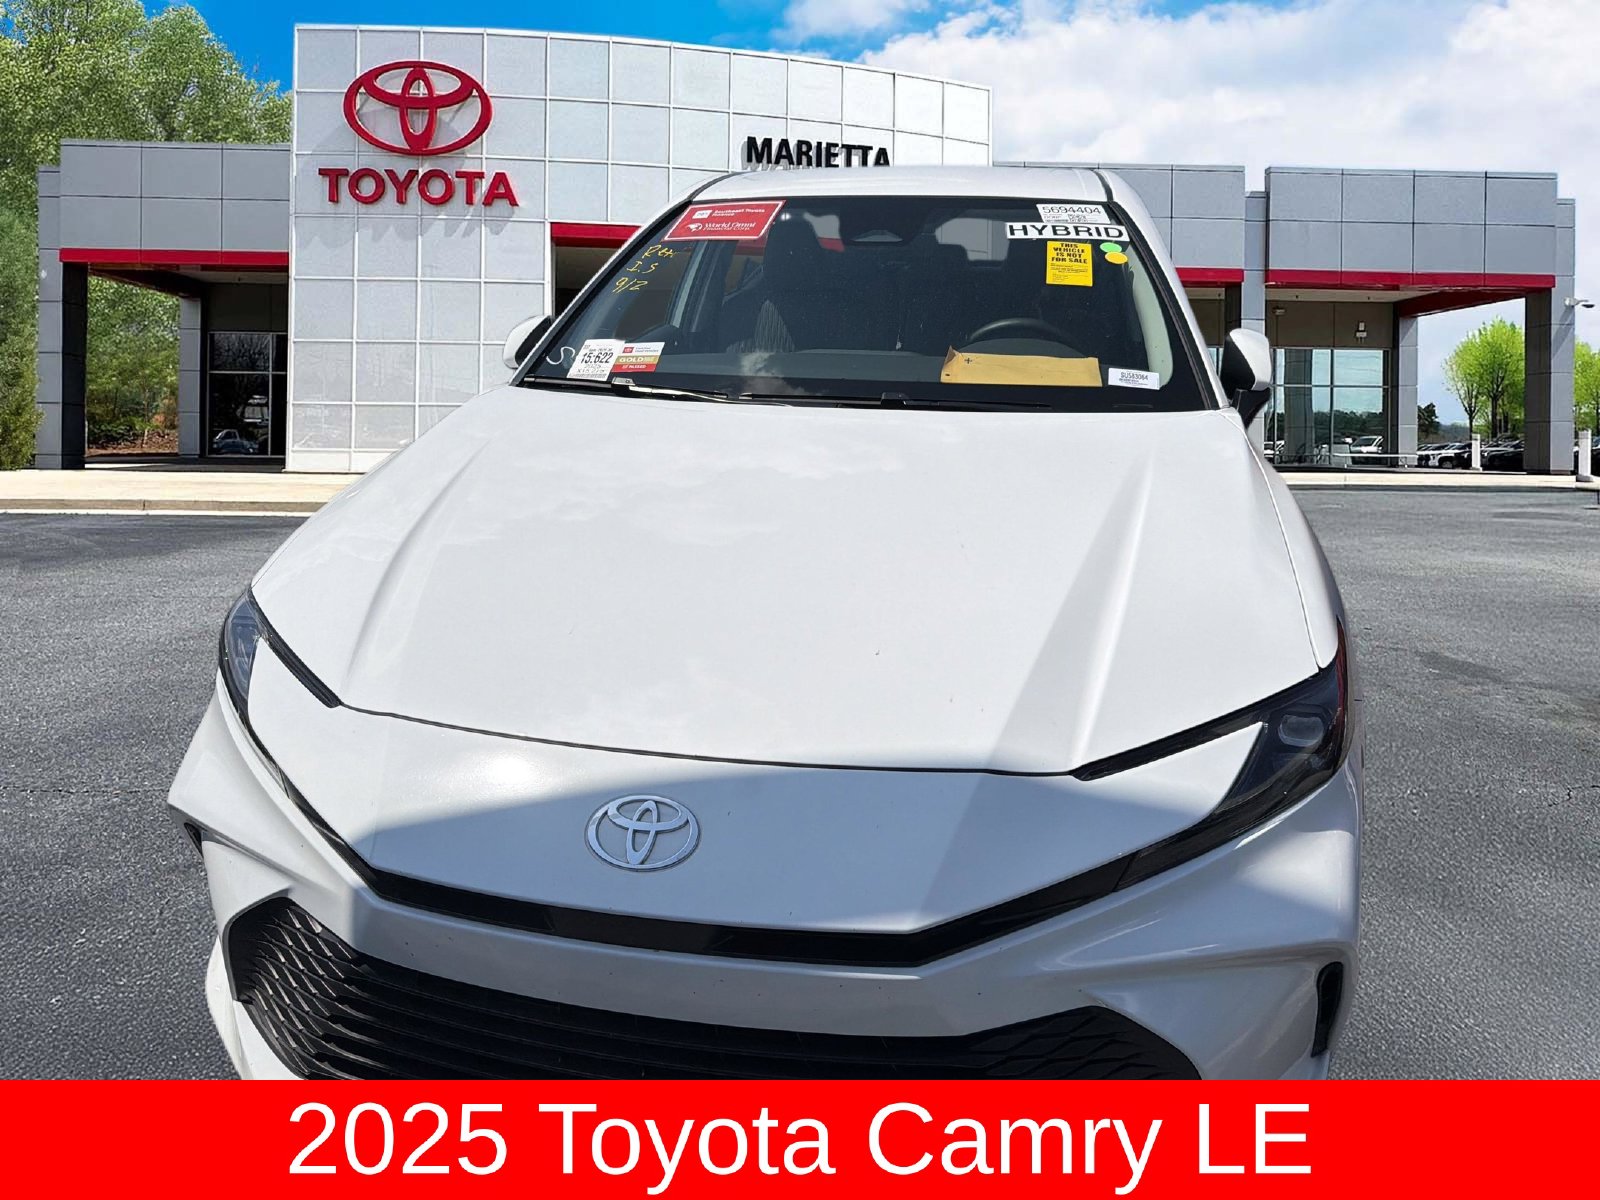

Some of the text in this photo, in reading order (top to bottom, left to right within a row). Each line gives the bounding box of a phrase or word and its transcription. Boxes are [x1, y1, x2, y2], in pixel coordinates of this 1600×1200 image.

[746, 136, 890, 168] MARIETTA
[318, 168, 519, 207] TOYOTA
[1042, 206, 1101, 214] 5694404
[1008, 224, 1124, 239] HYBRID
